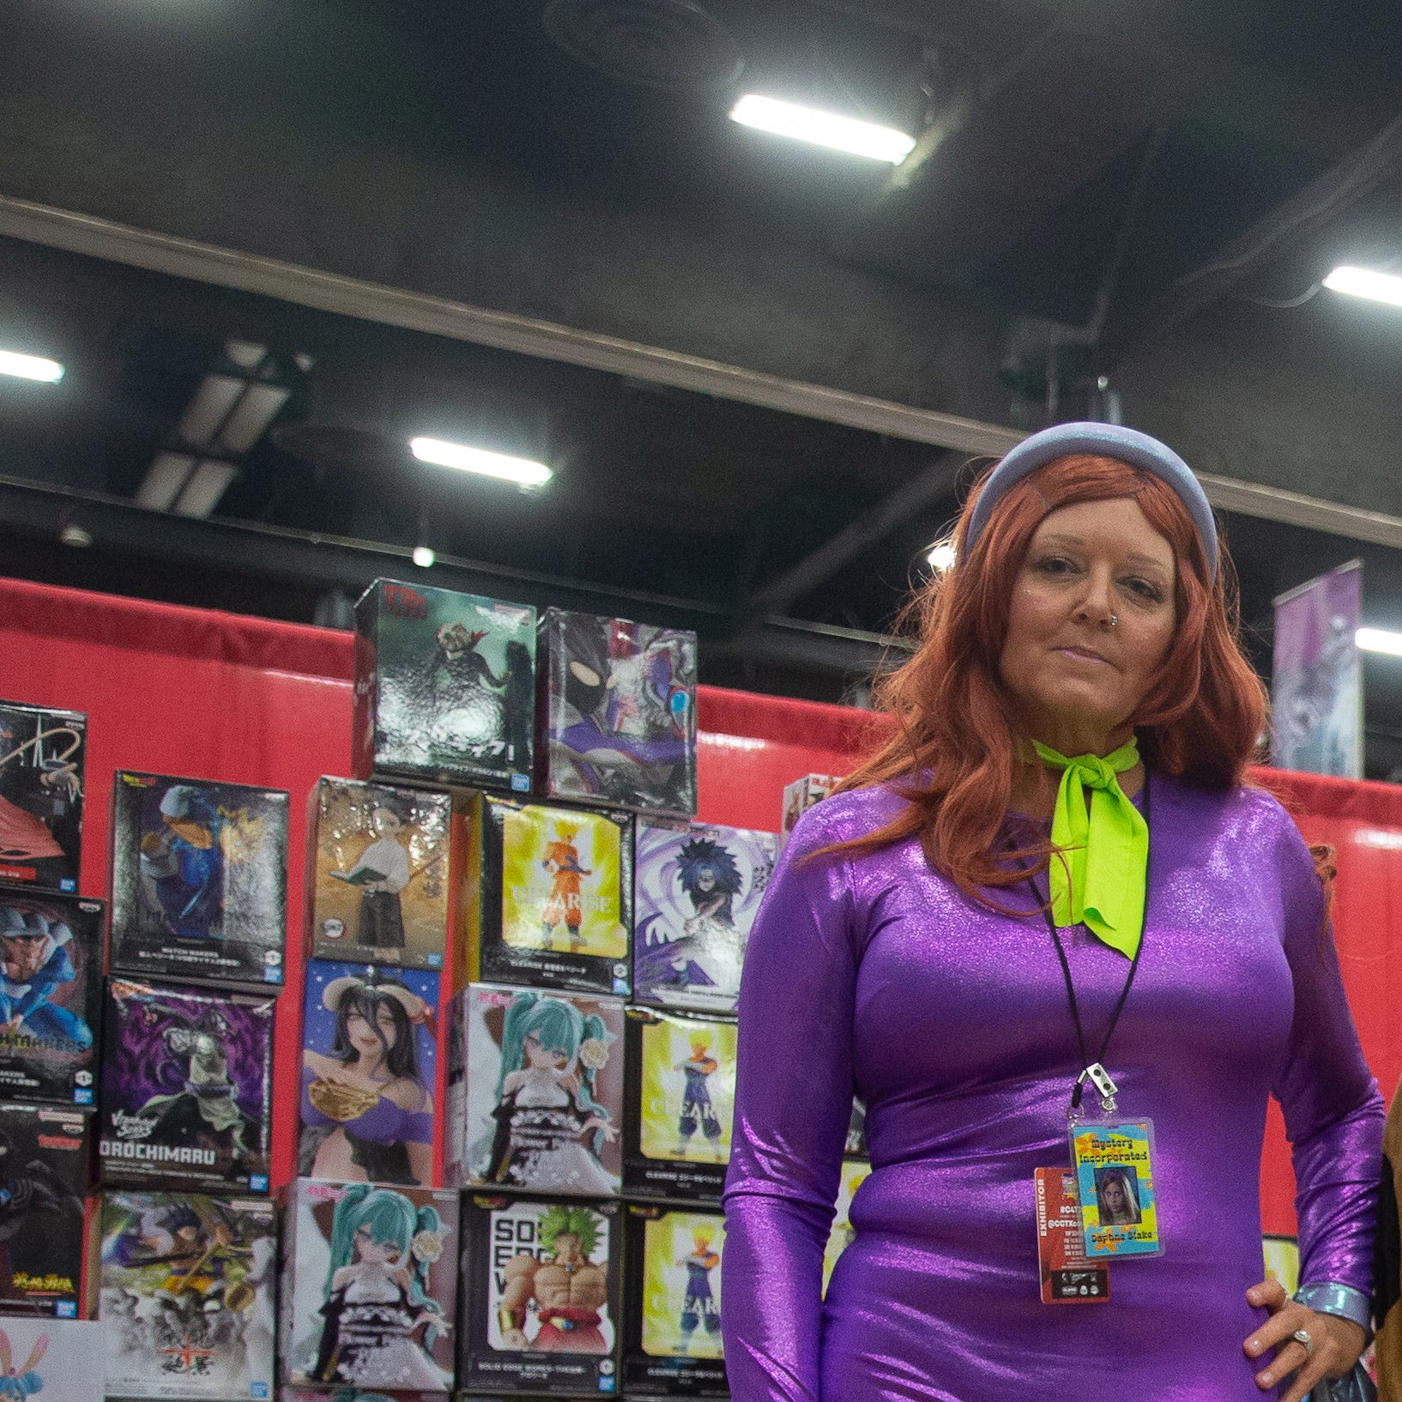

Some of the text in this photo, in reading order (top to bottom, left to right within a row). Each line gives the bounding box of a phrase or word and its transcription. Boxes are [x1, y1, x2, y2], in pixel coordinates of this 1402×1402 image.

[99, 1140, 217, 1166] OROCHIMARU
[1091, 1137, 1134, 1151] Mystery
[1079, 1150, 1148, 1164] Incorporated
[1037, 1179, 1047, 1237] EXHIBITOR
